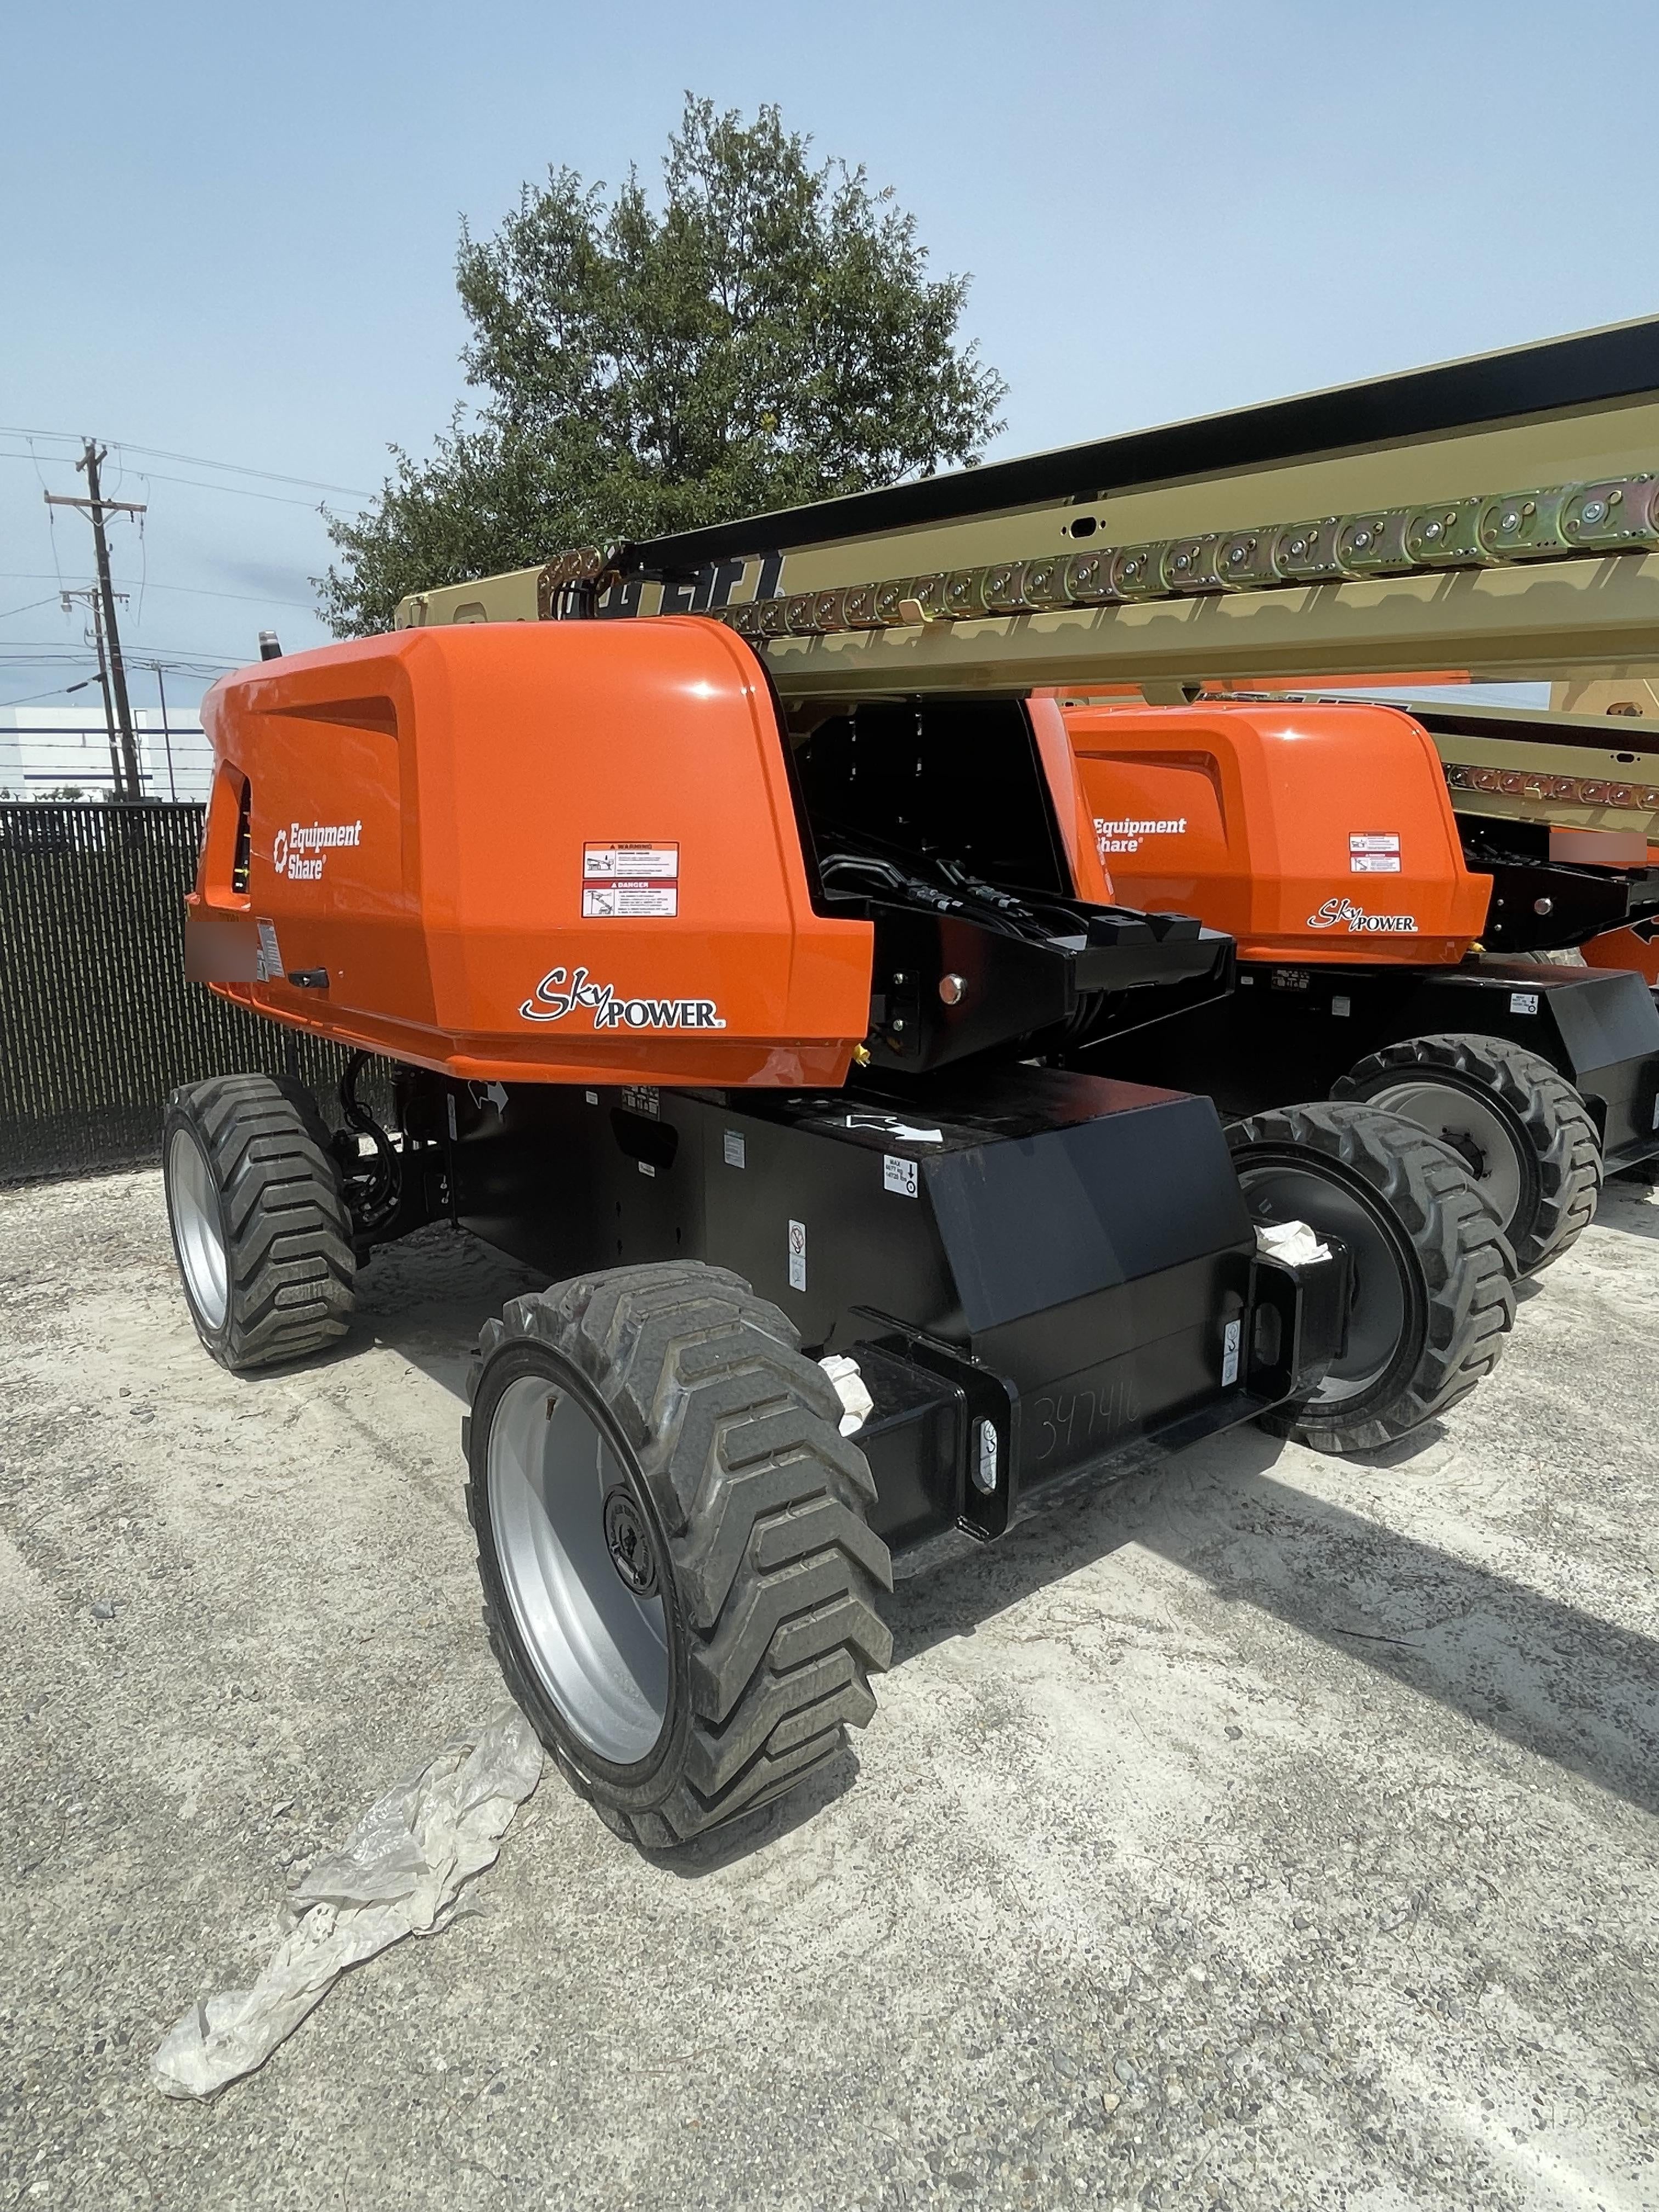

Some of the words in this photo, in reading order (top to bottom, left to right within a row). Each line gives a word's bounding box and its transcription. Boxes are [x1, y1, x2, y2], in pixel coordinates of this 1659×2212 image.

[290, 820, 362, 854] Equipment
[1093, 817, 1187, 837] Equipment
[1098, 836, 1138, 852] hare
